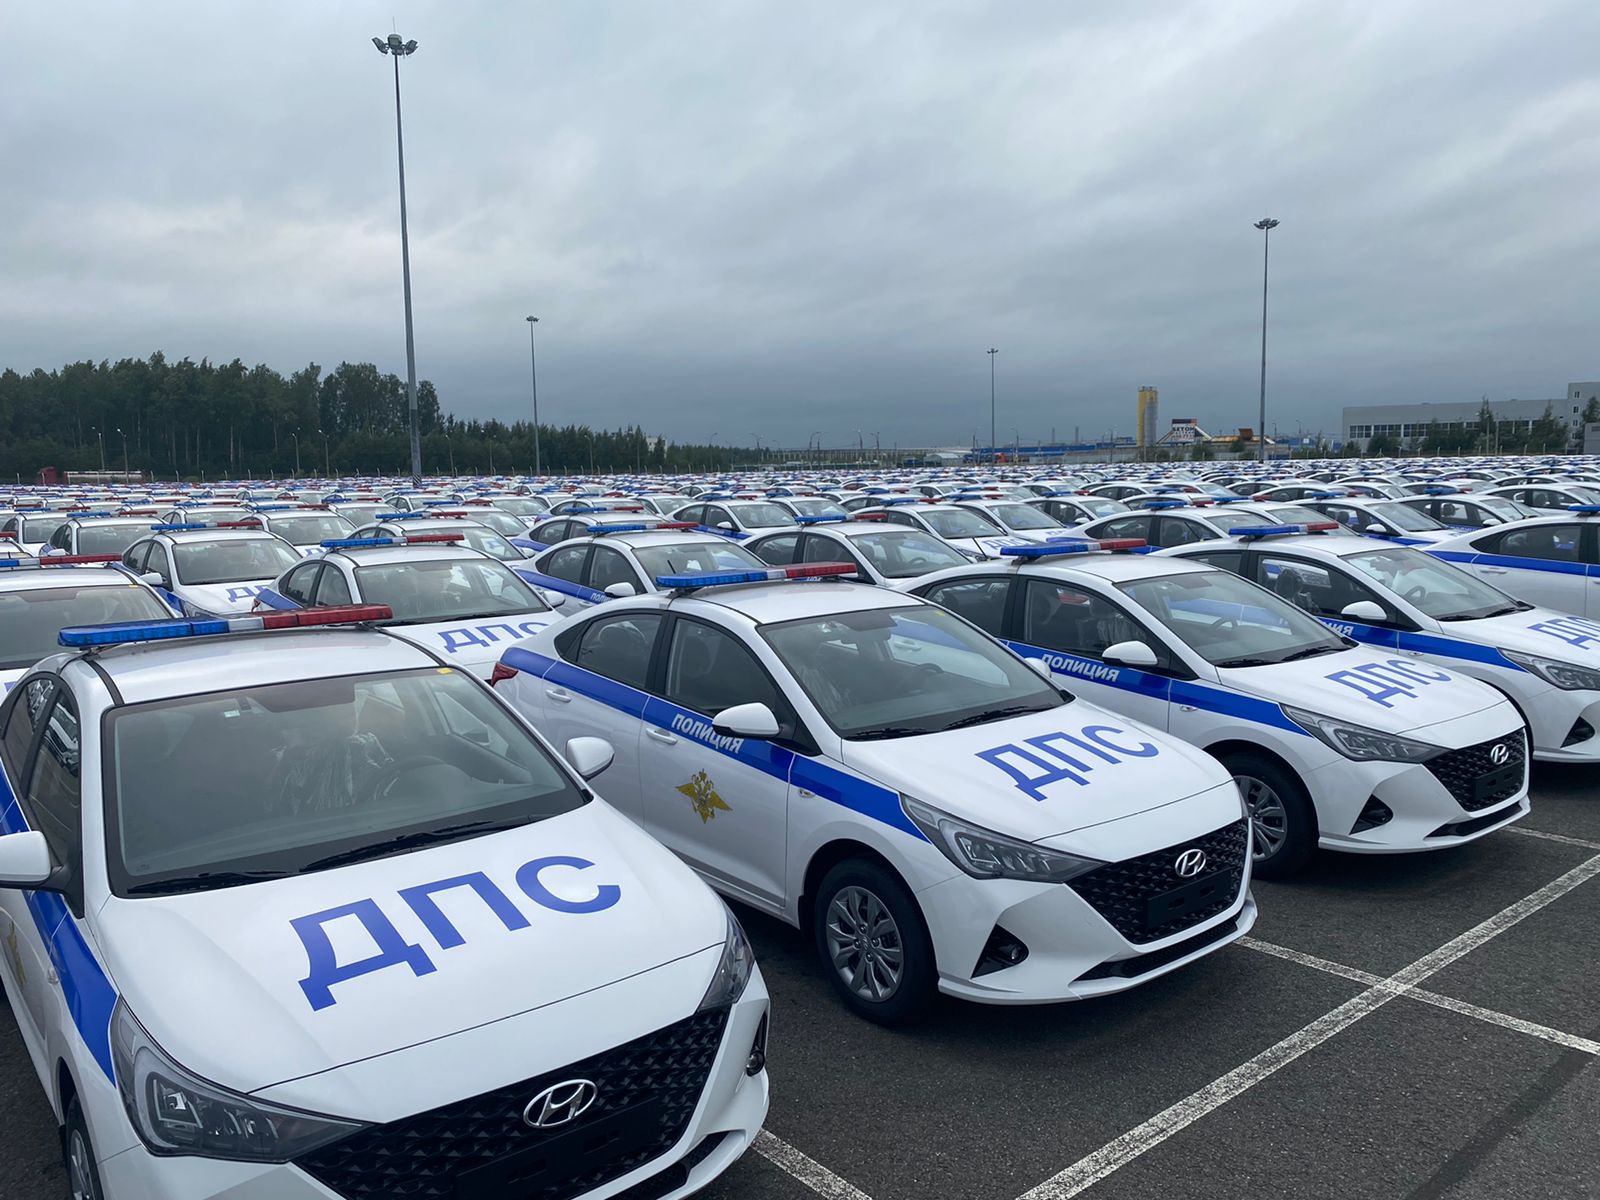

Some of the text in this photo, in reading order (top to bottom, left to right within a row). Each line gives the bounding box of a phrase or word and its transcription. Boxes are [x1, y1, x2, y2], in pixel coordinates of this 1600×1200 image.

[1041, 653, 1120, 682] ПОЛИЦИЯ
[1323, 659, 1452, 708] ДПС
[671, 713, 745, 754] ПОЛИЦИЯ
[974, 725, 1160, 802] ДПС
[289, 855, 622, 1012] ДПС
